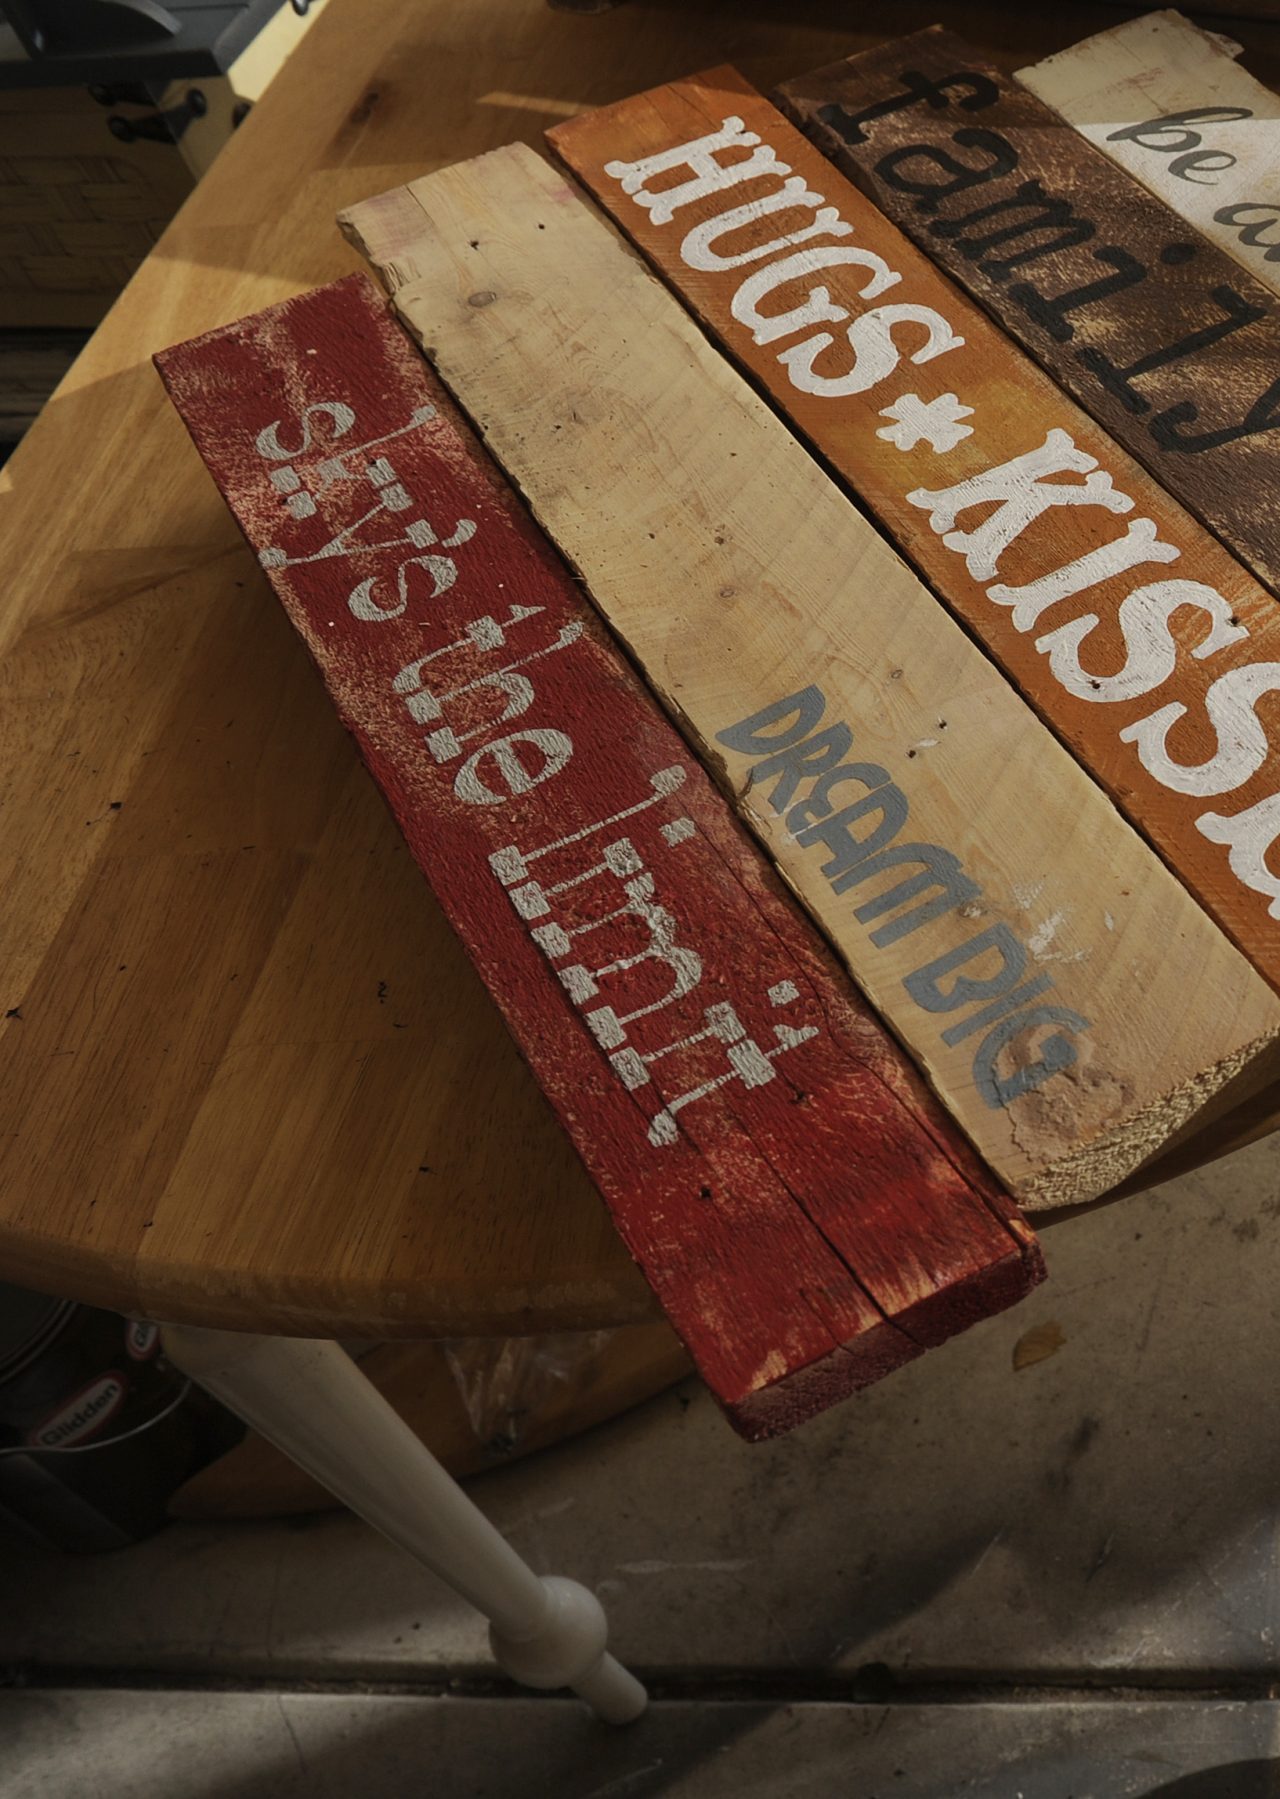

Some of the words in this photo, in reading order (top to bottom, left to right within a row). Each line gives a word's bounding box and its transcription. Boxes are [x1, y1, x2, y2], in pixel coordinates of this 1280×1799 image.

[604, 115, 966, 397] HUGS
[1106, 105, 1253, 186] be
[256, 401, 478, 622] sky's
[392, 604, 584, 806] the
[488, 764, 819, 1148] limit
[715, 684, 984, 949] DREAM
[902, 921, 1092, 1110] BIG
[41, 1384, 118, 1445] Glidden
